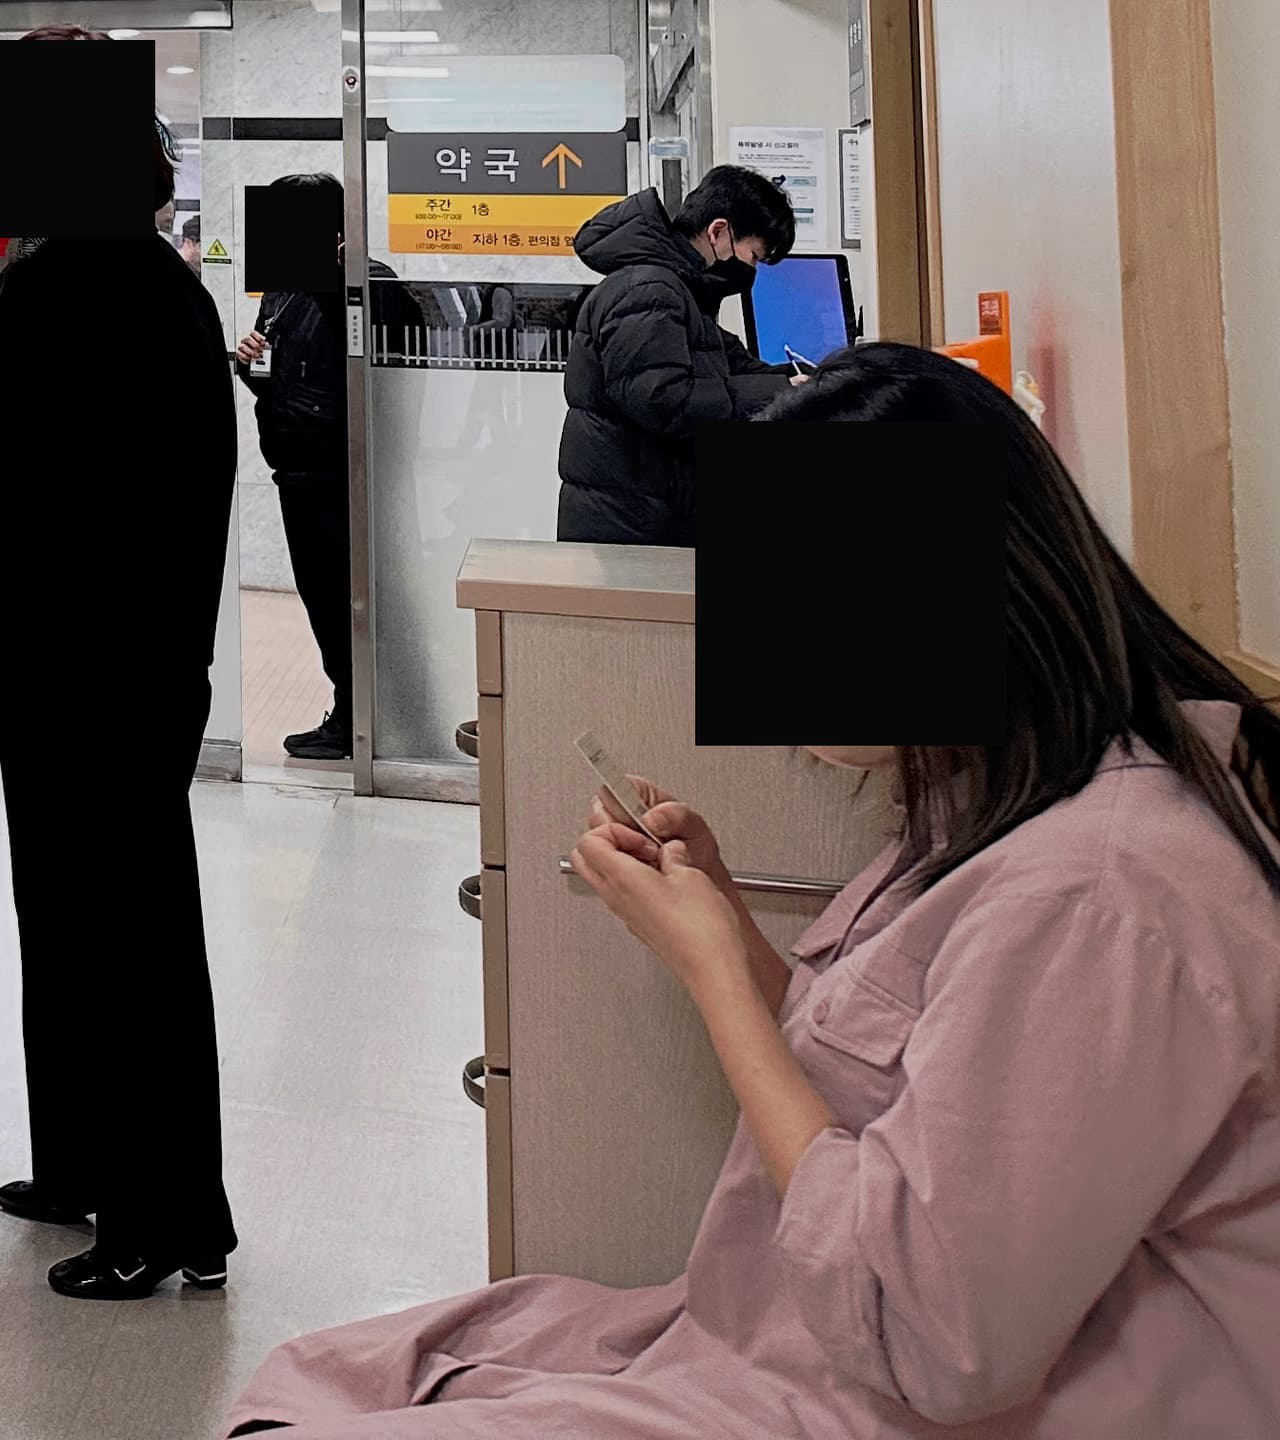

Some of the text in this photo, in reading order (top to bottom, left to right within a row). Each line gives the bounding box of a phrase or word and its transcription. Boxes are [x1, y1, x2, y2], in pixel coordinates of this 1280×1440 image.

[426, 199, 490, 216] 주간 1층
[426, 228, 452, 241] 야간
[473, 233, 498, 247] 지하
[528, 234, 560, 247] 편의점
